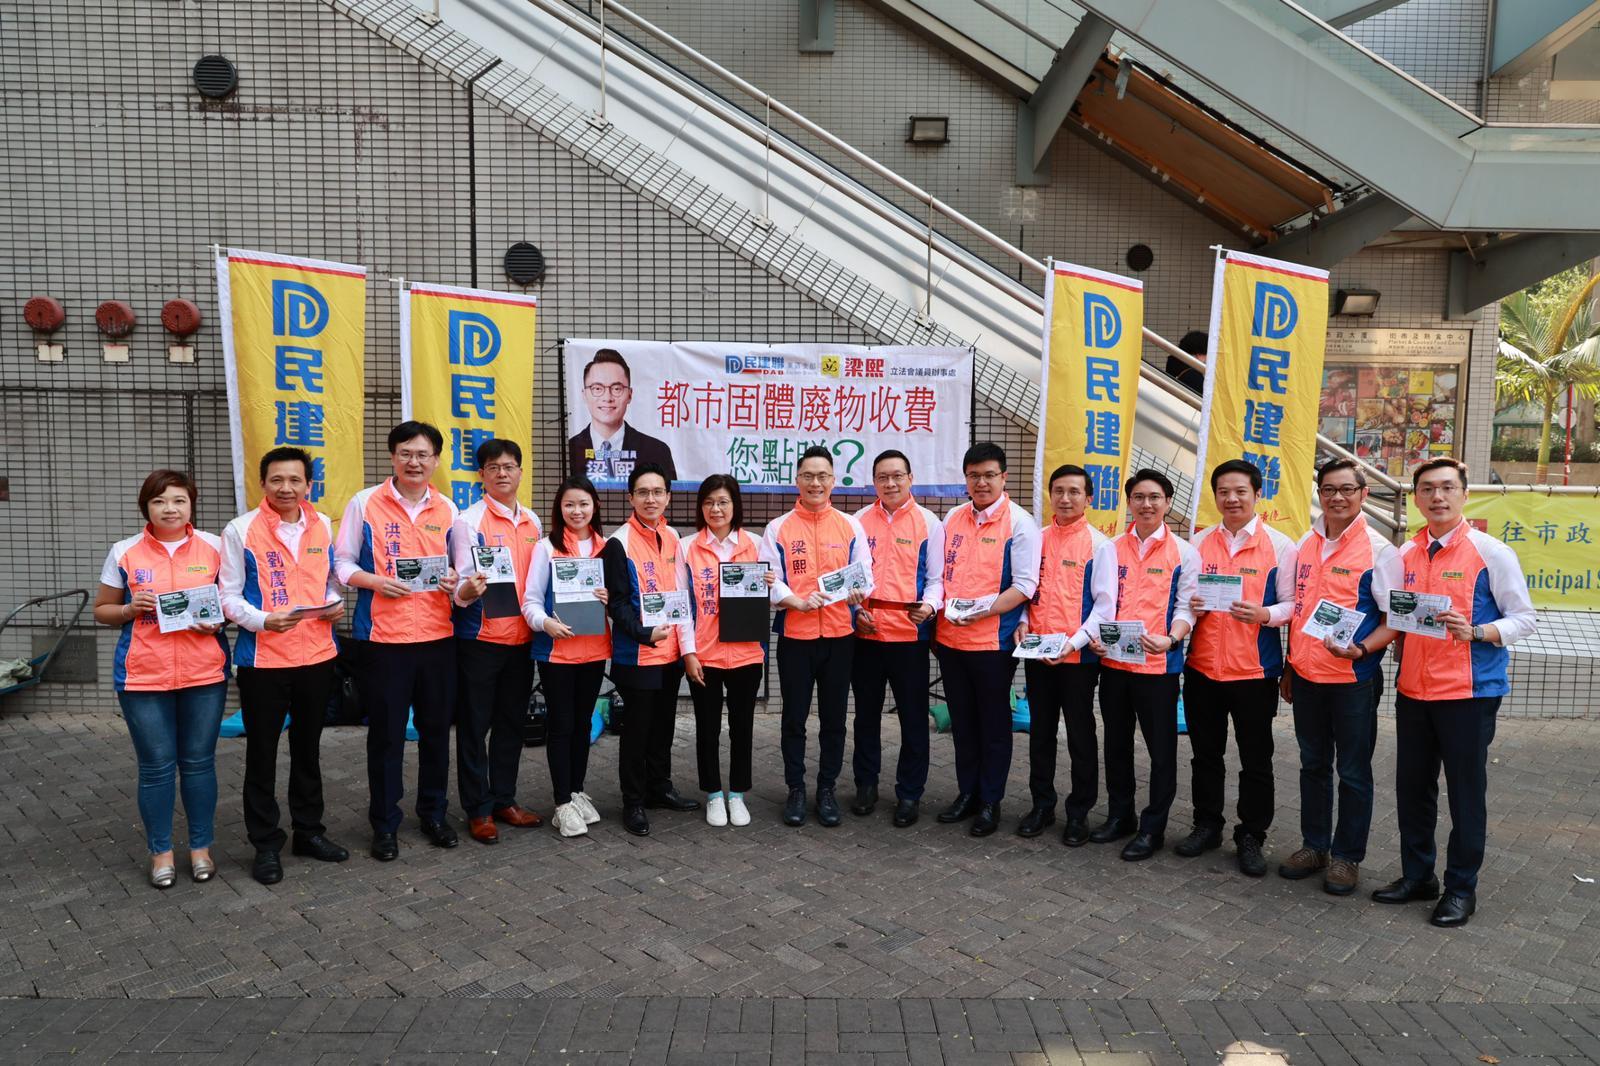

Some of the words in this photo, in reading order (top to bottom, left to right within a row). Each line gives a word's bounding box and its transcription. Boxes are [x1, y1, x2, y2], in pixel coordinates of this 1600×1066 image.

[744, 356, 785, 369] 民建聯
[844, 358, 884, 377] 梁熙
[890, 367, 957, 377] 立法會議員辦事處
[656, 380, 936, 433] 都市固體廢物收費
[1084, 355, 1121, 511] 民建聯
[727, 437, 865, 486] 您點?
[790, 540, 807, 574] 梁熙
[1501, 520, 1593, 546] 往市政
[265, 551, 289, 607] 劉慶揚
[700, 567, 717, 615] 李清霞
[1526, 568, 1591, 594] nicipal
